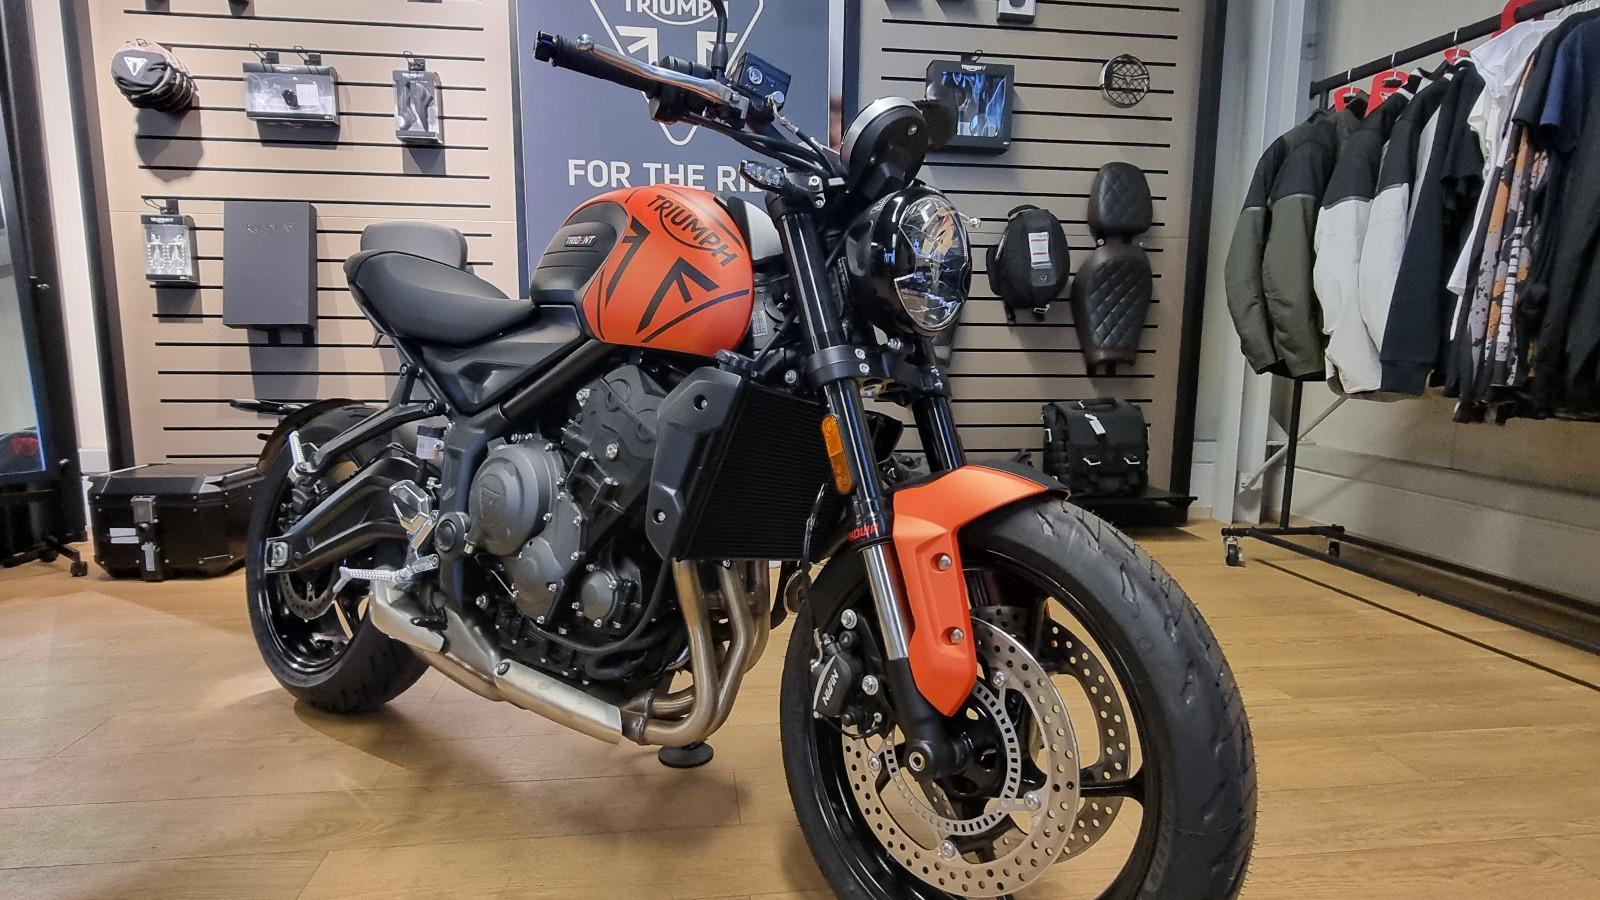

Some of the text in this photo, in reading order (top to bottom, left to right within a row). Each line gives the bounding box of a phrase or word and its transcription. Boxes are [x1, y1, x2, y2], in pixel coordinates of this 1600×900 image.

[568, 159, 631, 187] FOR
[643, 162, 705, 191] THE
[565, 235, 596, 245] TRIDENT
[647, 194, 738, 267] TRIUMPH
